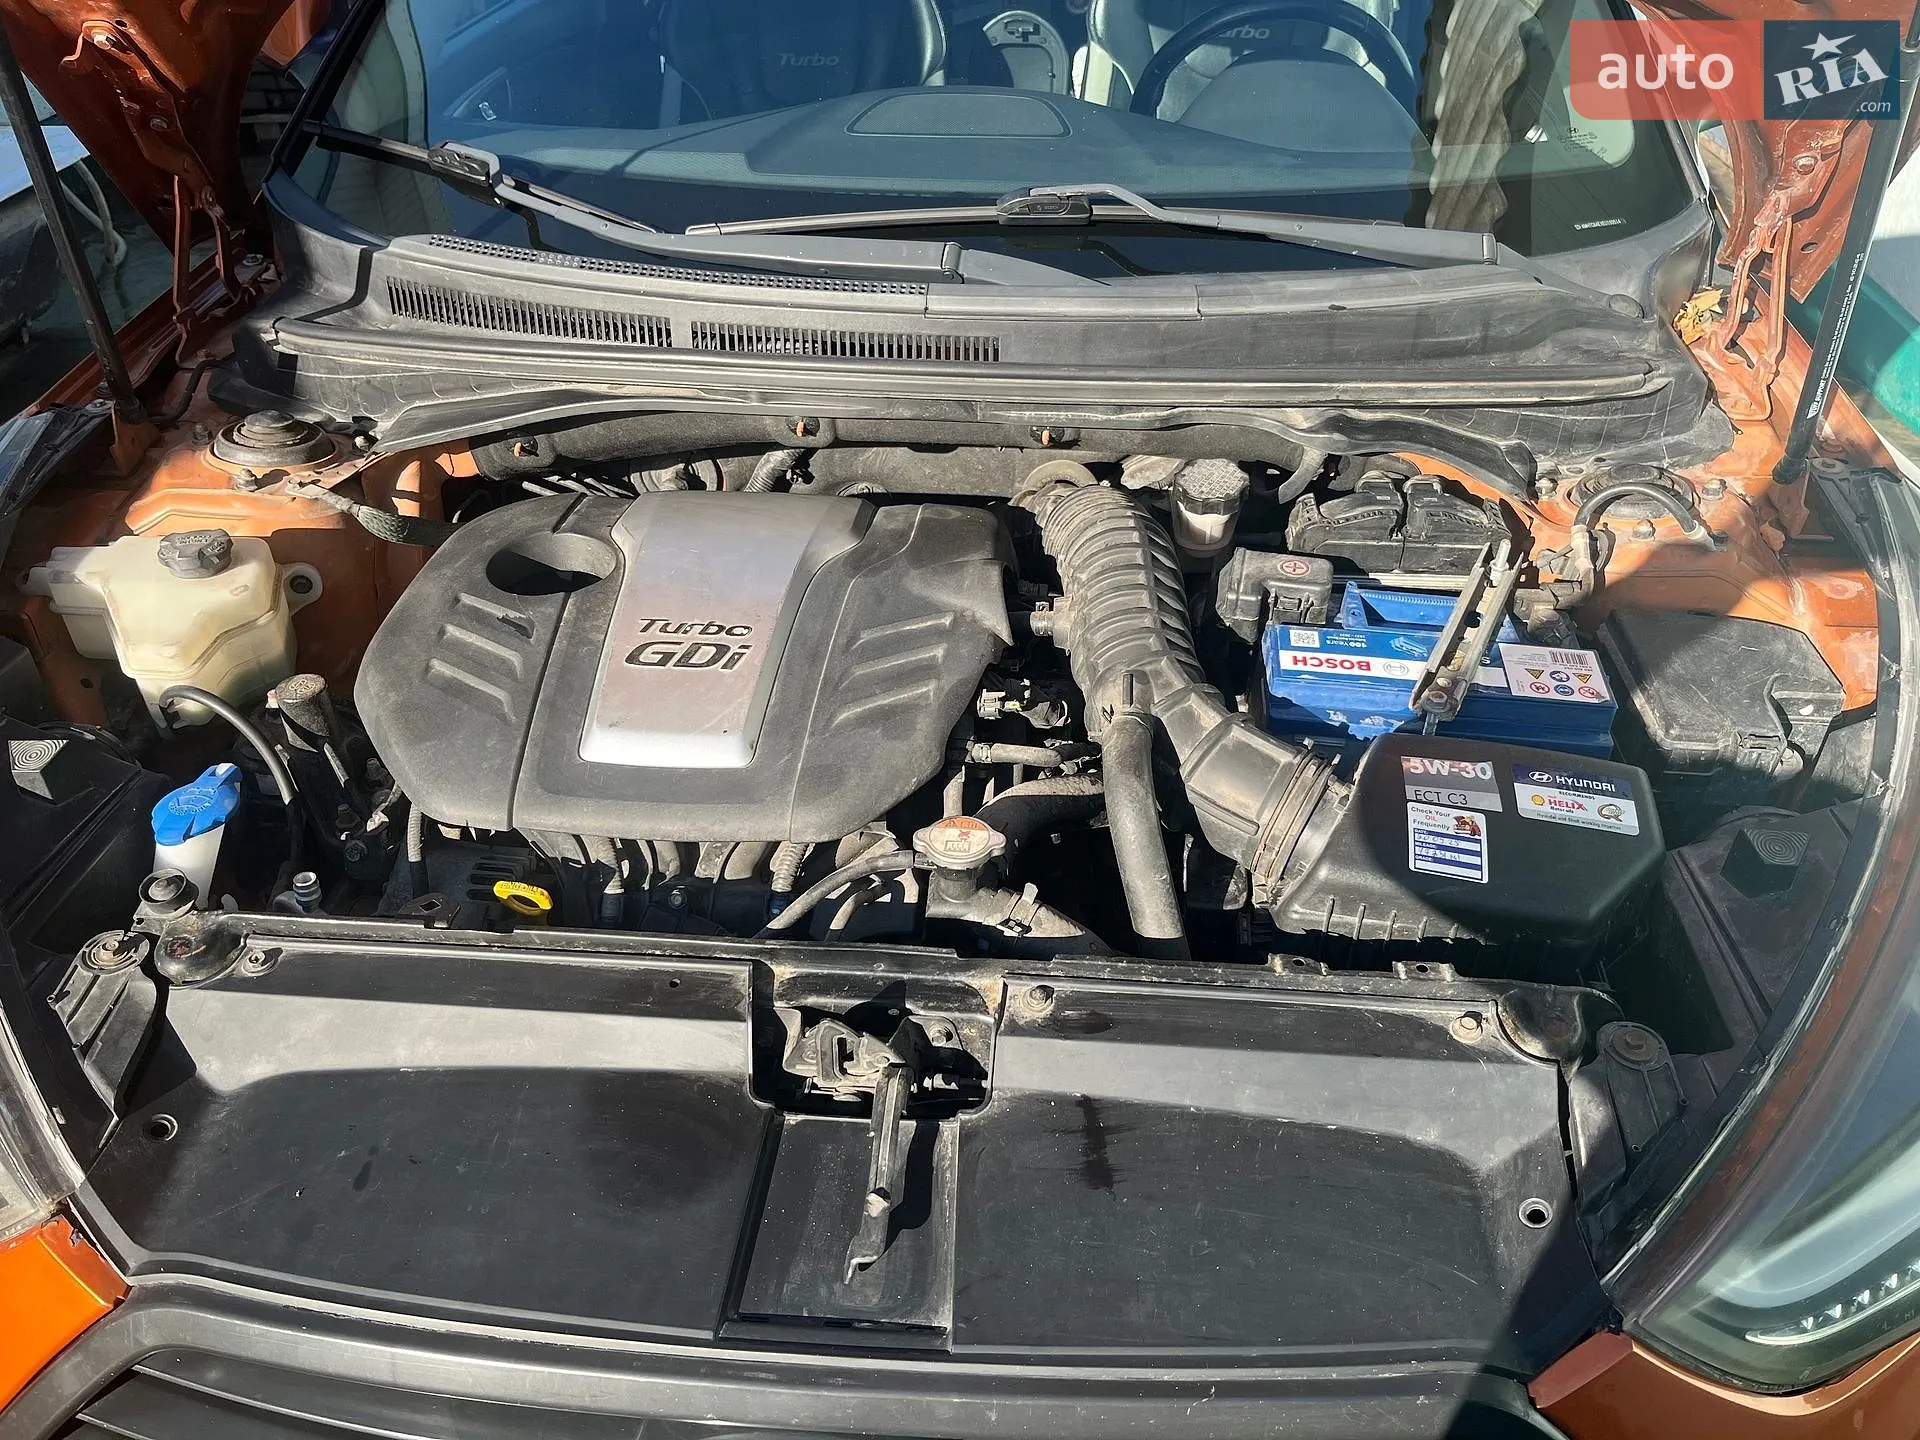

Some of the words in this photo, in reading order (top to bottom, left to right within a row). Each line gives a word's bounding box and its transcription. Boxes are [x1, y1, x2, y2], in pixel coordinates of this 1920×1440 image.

[776, 52, 839, 66] Turbo
[639, 618, 753, 637] Turbo
[624, 641, 753, 671] GDi
[1292, 655, 1371, 671] BOSCH
[1409, 758, 1493, 780] 5W-30
[1555, 775, 1616, 792] HYUNDAI
[1414, 789, 1441, 802] ECT
[1447, 792, 1468, 805] C3
[1548, 799, 1586, 811] HELIX
[1410, 806, 1433, 815] Check
[1434, 810, 1451, 818] Your
[1413, 819, 1450, 831] Frequently
